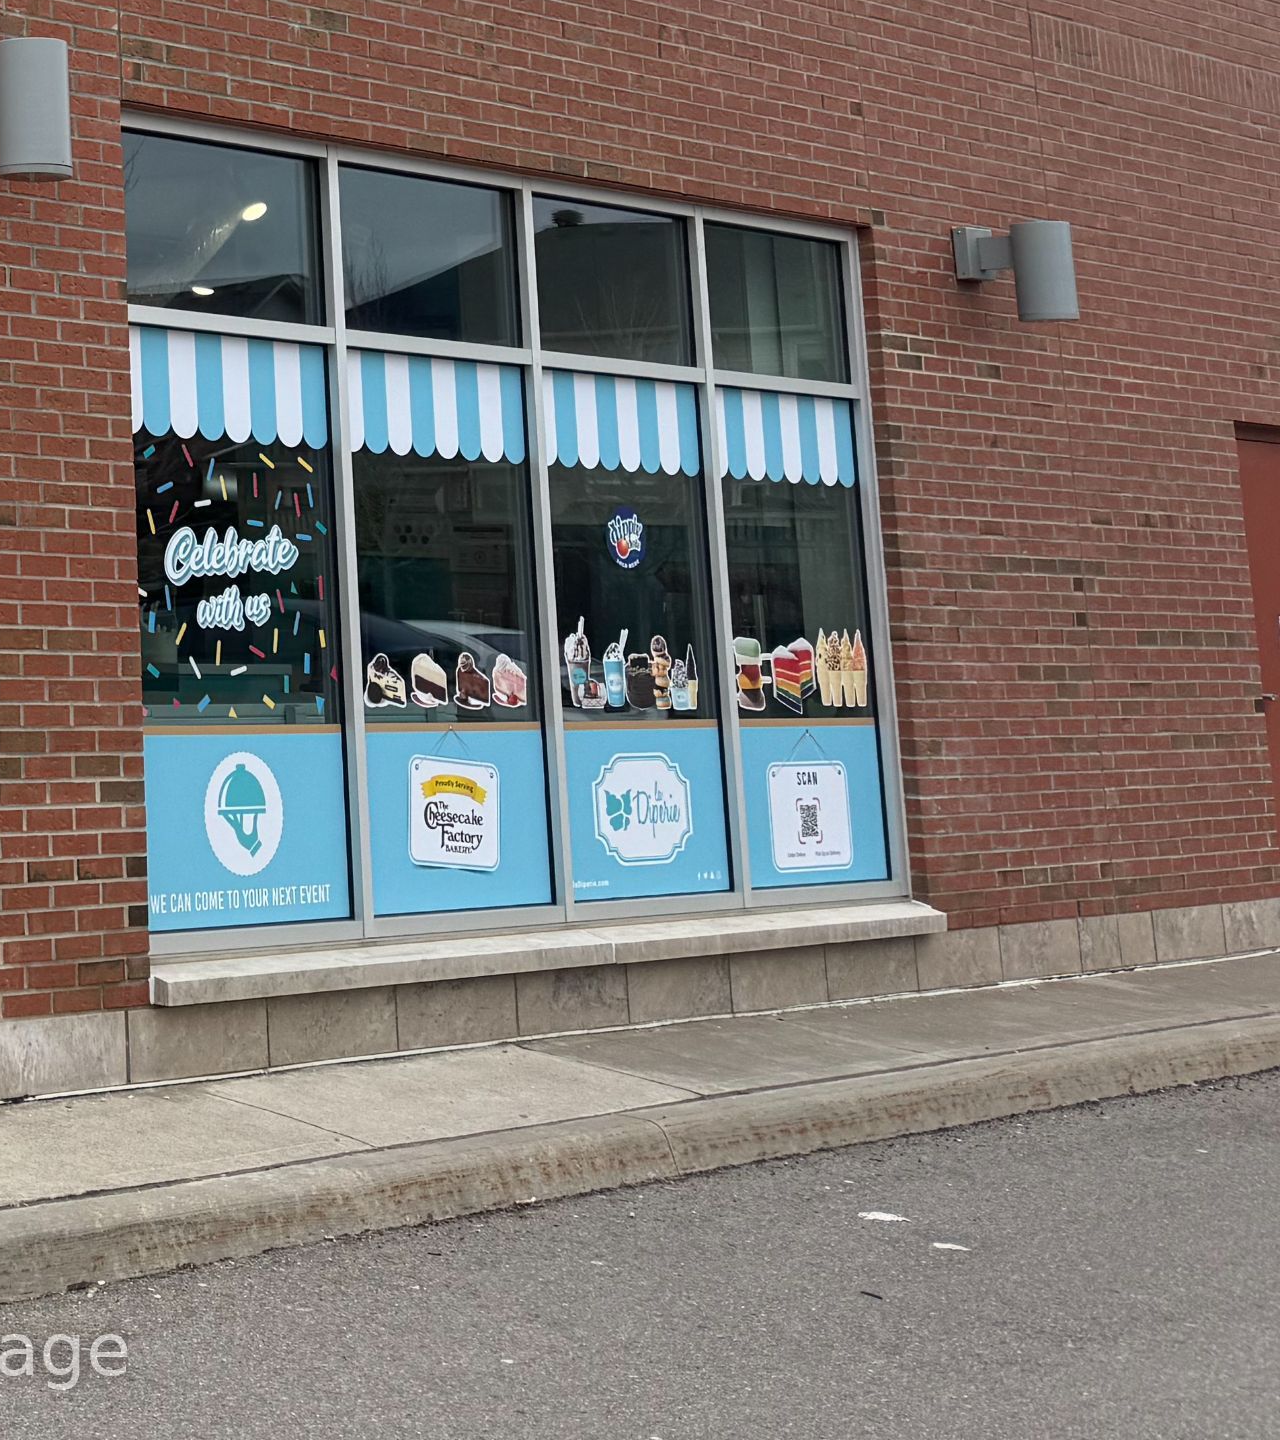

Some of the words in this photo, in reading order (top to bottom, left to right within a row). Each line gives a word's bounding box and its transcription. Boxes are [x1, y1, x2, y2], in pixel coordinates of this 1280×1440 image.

[164, 524, 299, 587] Celebrate
[196, 584, 246, 632] with
[244, 592, 272, 628] us
[435, 779, 454, 789] Proudly
[454, 780, 474, 794] Serving
[796, 771, 818, 786] SCAN
[424, 801, 484, 830] Cheesecake
[438, 800, 449, 810] The
[632, 790, 681, 839] Diperie
[436, 822, 484, 851] Factory
[150, 894, 167, 914] WE
[170, 893, 191, 913] CAN
[195, 890, 224, 911] COME
[226, 889, 240, 909] TO
[241, 888, 269, 908] YOUR
[272, 886, 297, 906] NEXT
[299, 884, 331, 904] EVENT
